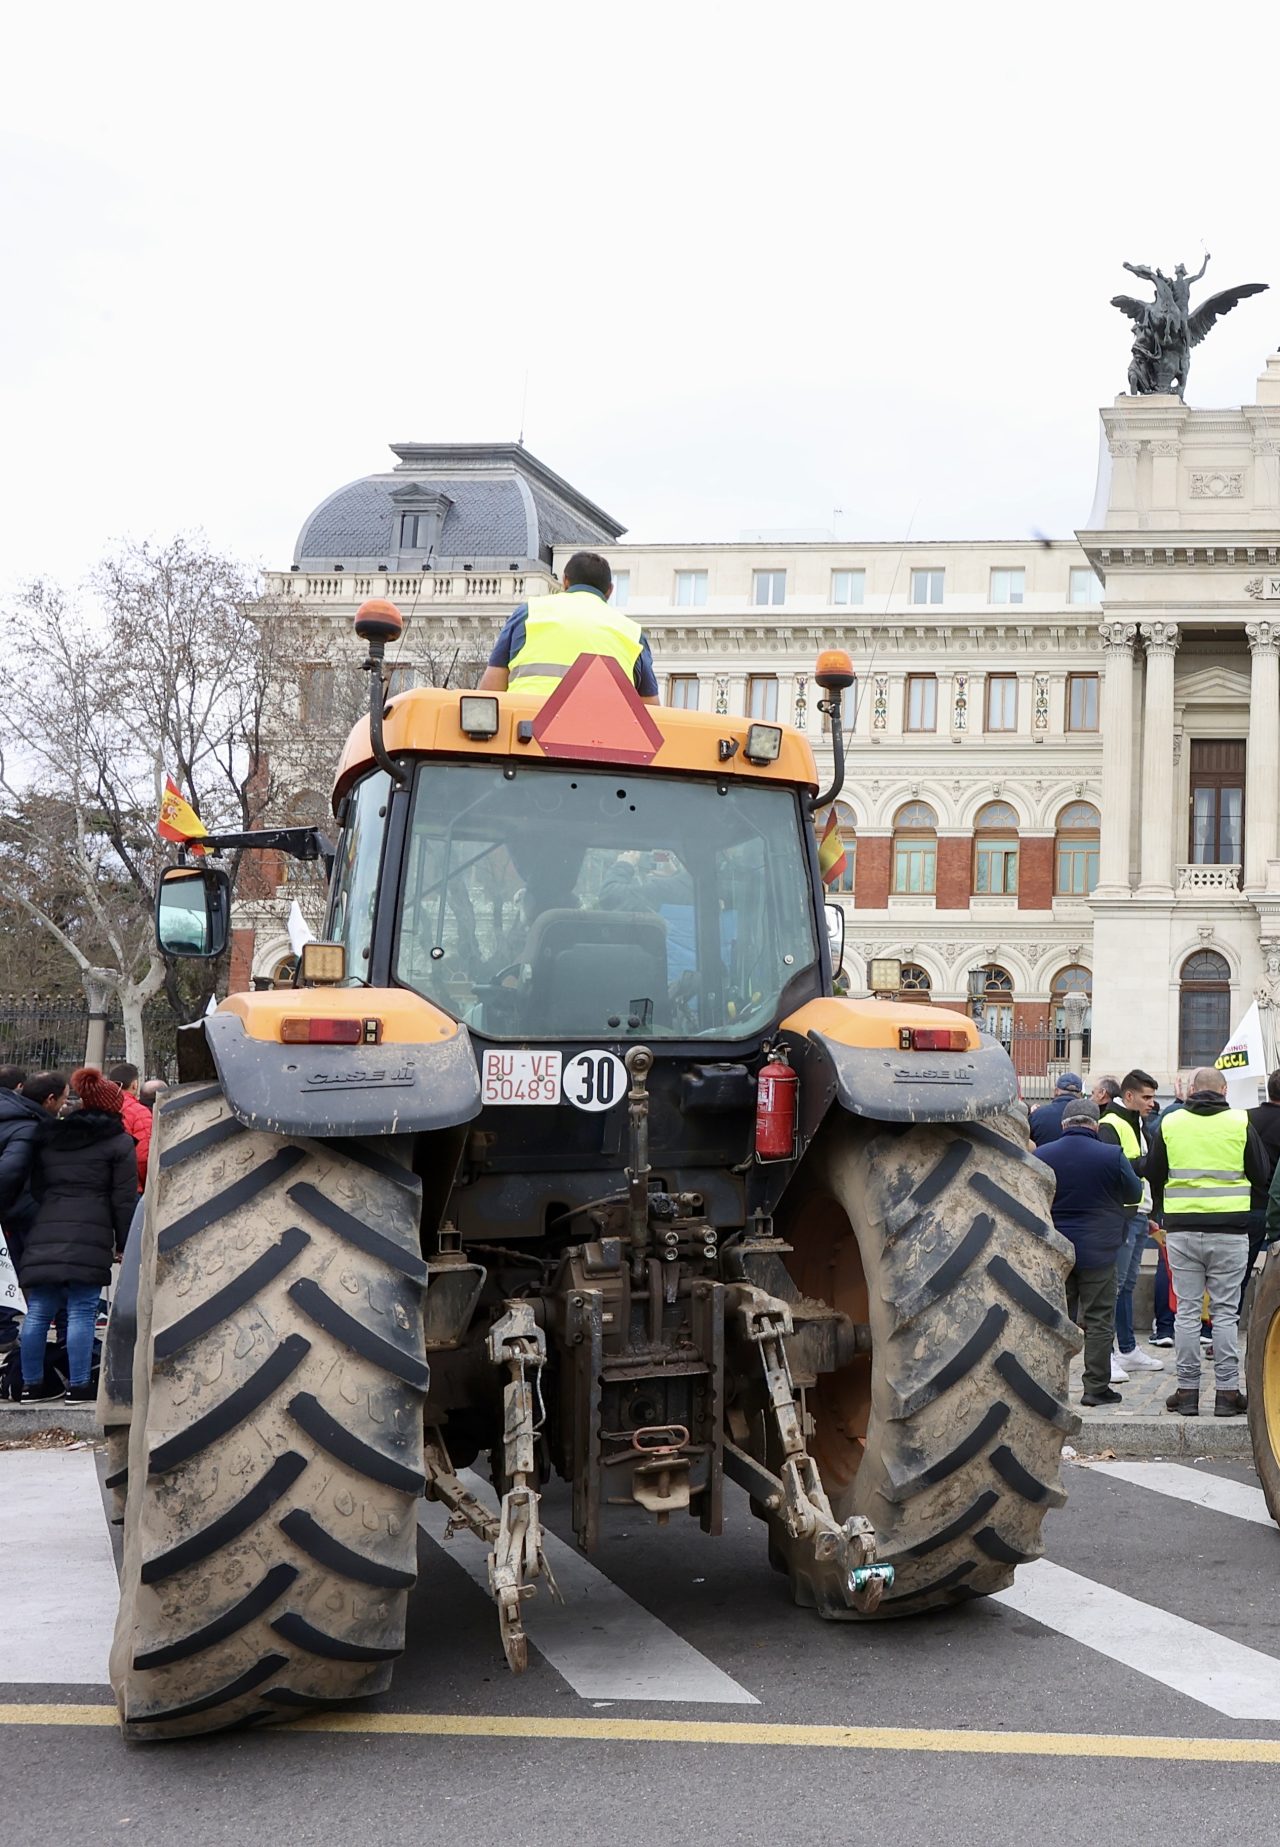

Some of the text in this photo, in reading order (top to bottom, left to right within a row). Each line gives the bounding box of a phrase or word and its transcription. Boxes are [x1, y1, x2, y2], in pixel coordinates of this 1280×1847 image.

[307, 1070, 386, 1084] CASE
[576, 1056, 615, 1105] 30
[894, 1070, 950, 1079] CASE
[486, 1079, 556, 1101] 50489
